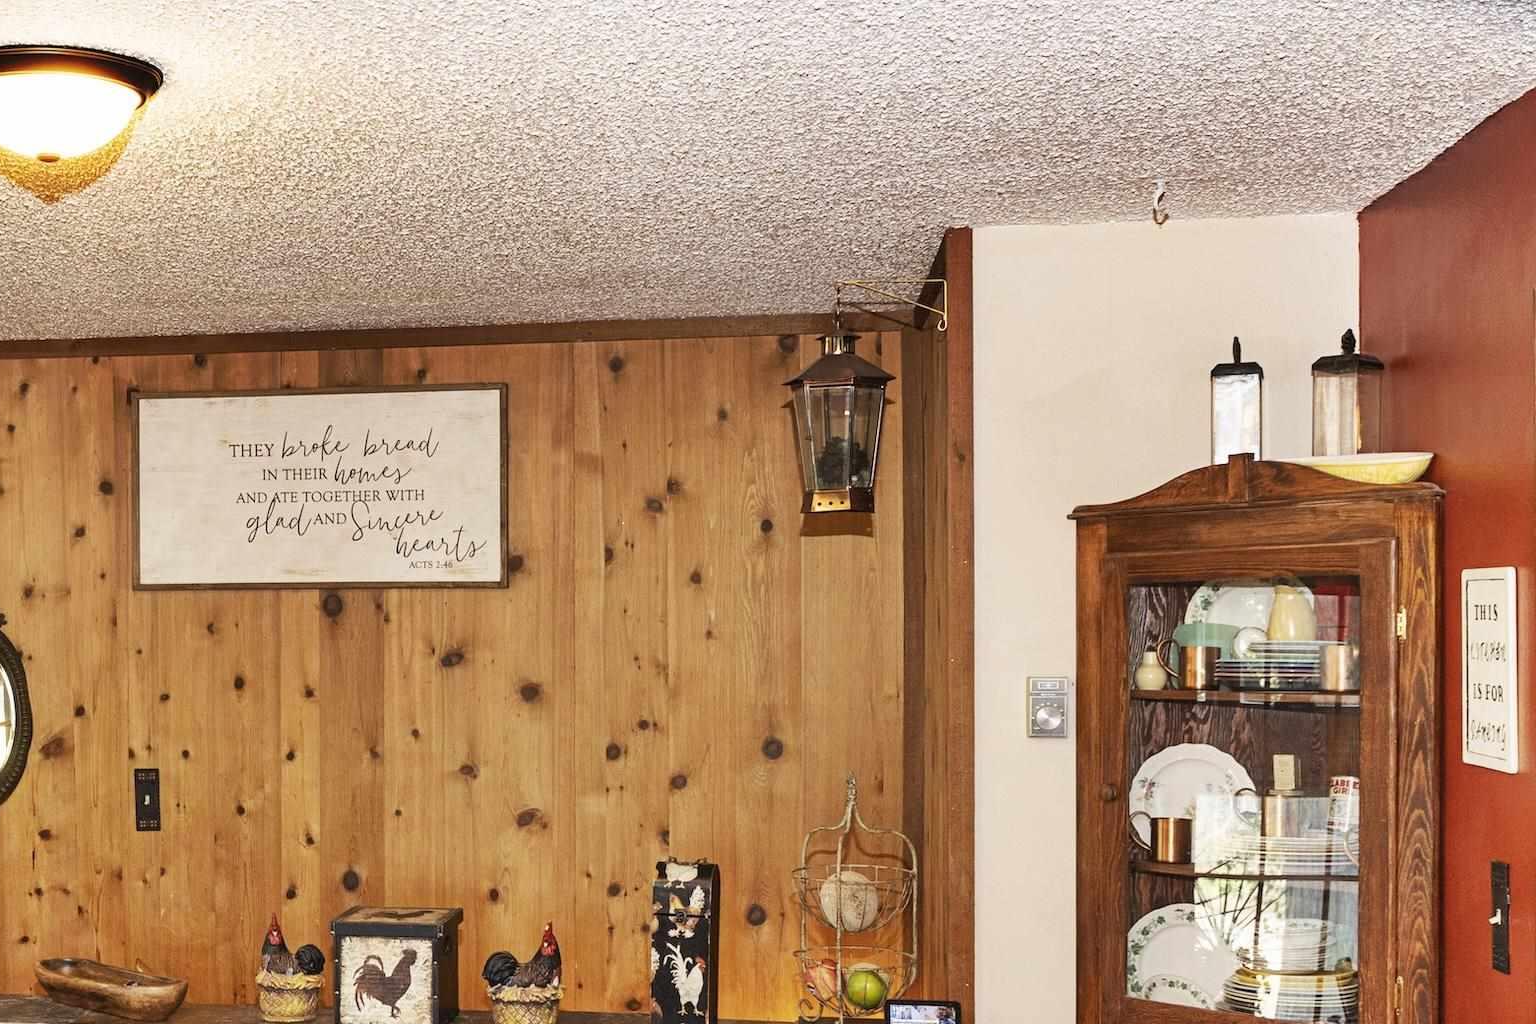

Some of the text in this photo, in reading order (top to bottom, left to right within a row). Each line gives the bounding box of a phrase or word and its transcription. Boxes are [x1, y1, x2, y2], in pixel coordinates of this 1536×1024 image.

[229, 424, 440, 461] THEY broke bread
[262, 455, 412, 485] IN THEIR homes
[235, 489, 425, 504] AND ATE TOGETHER WITH
[246, 498, 313, 543] glad
[313, 512, 347, 526] AND
[395, 525, 487, 562] hearts
[408, 560, 433, 569] ACTS
[1474, 603, 1499, 621] THIS
[1473, 682, 1504, 703] IS FOR
